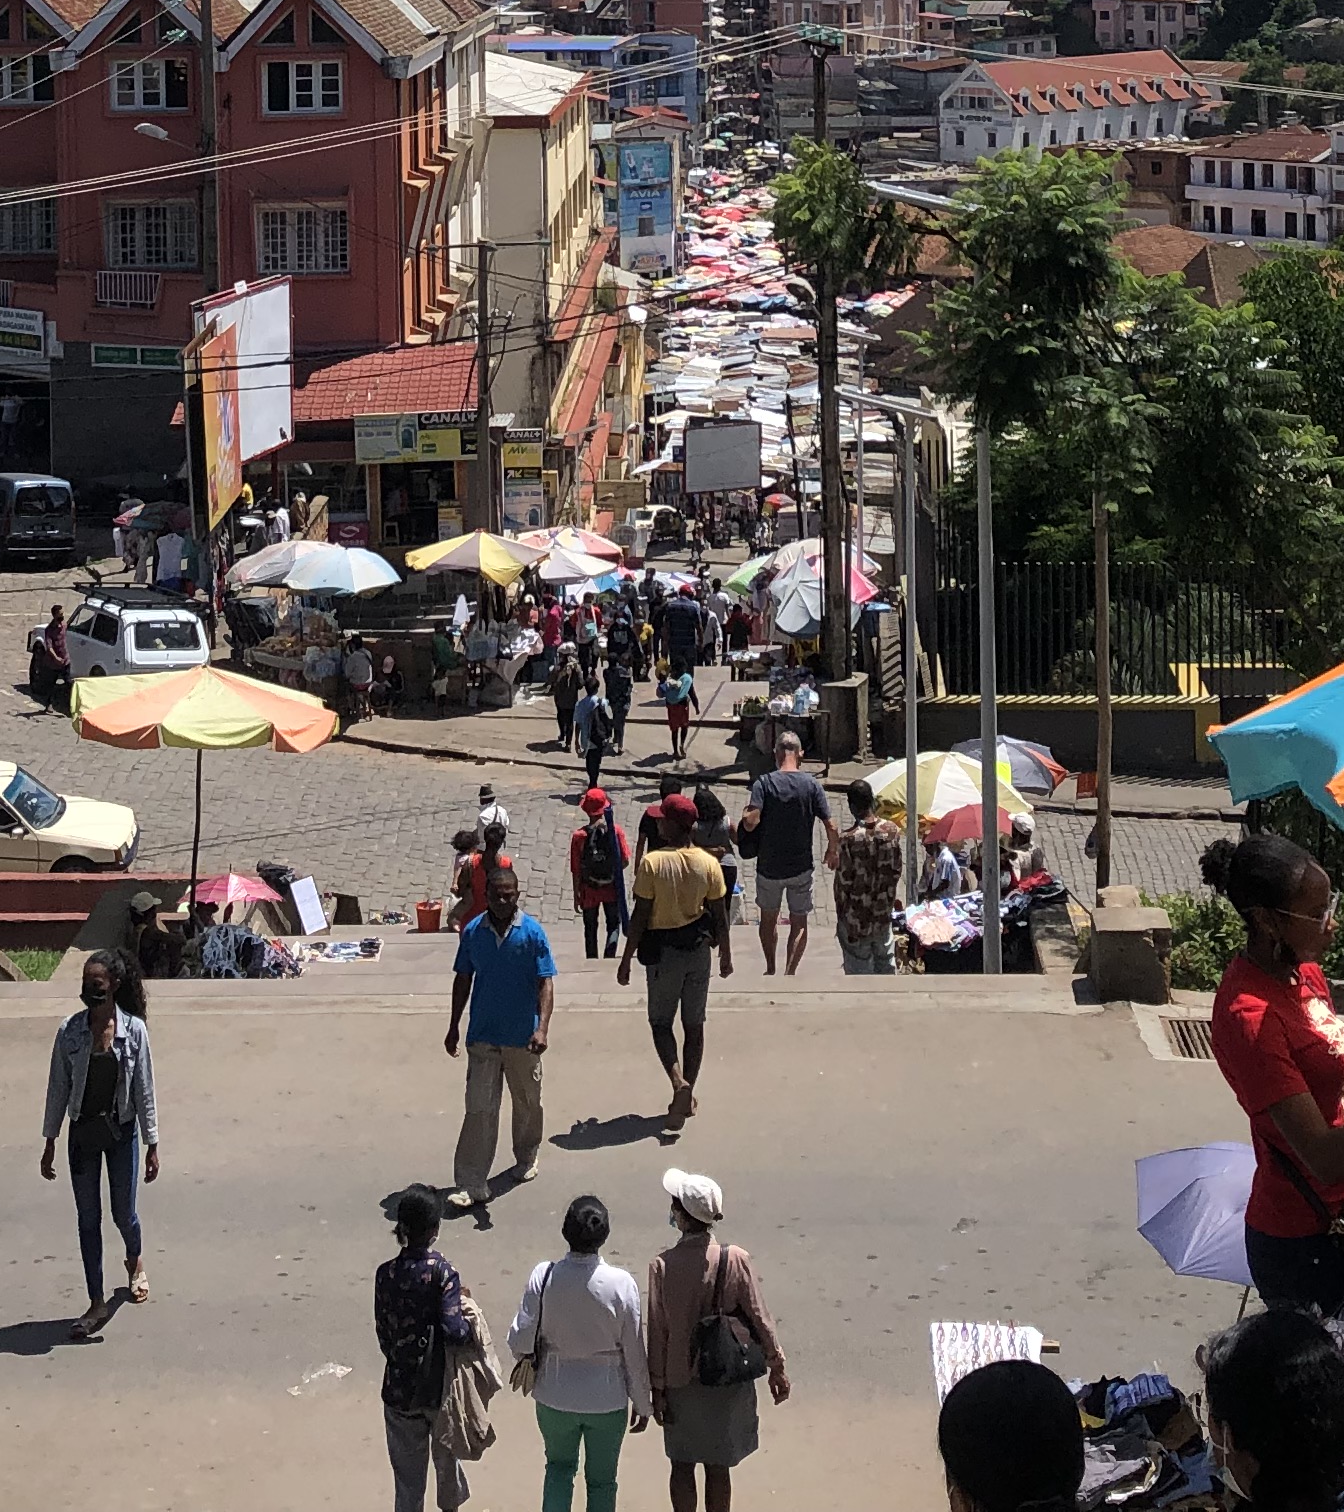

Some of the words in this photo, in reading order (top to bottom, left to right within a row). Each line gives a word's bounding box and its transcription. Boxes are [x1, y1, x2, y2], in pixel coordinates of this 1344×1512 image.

[630, 190, 661, 198] AVIA
[421, 411, 477, 424] CANAL+
[504, 431, 541, 439] CANAL+
